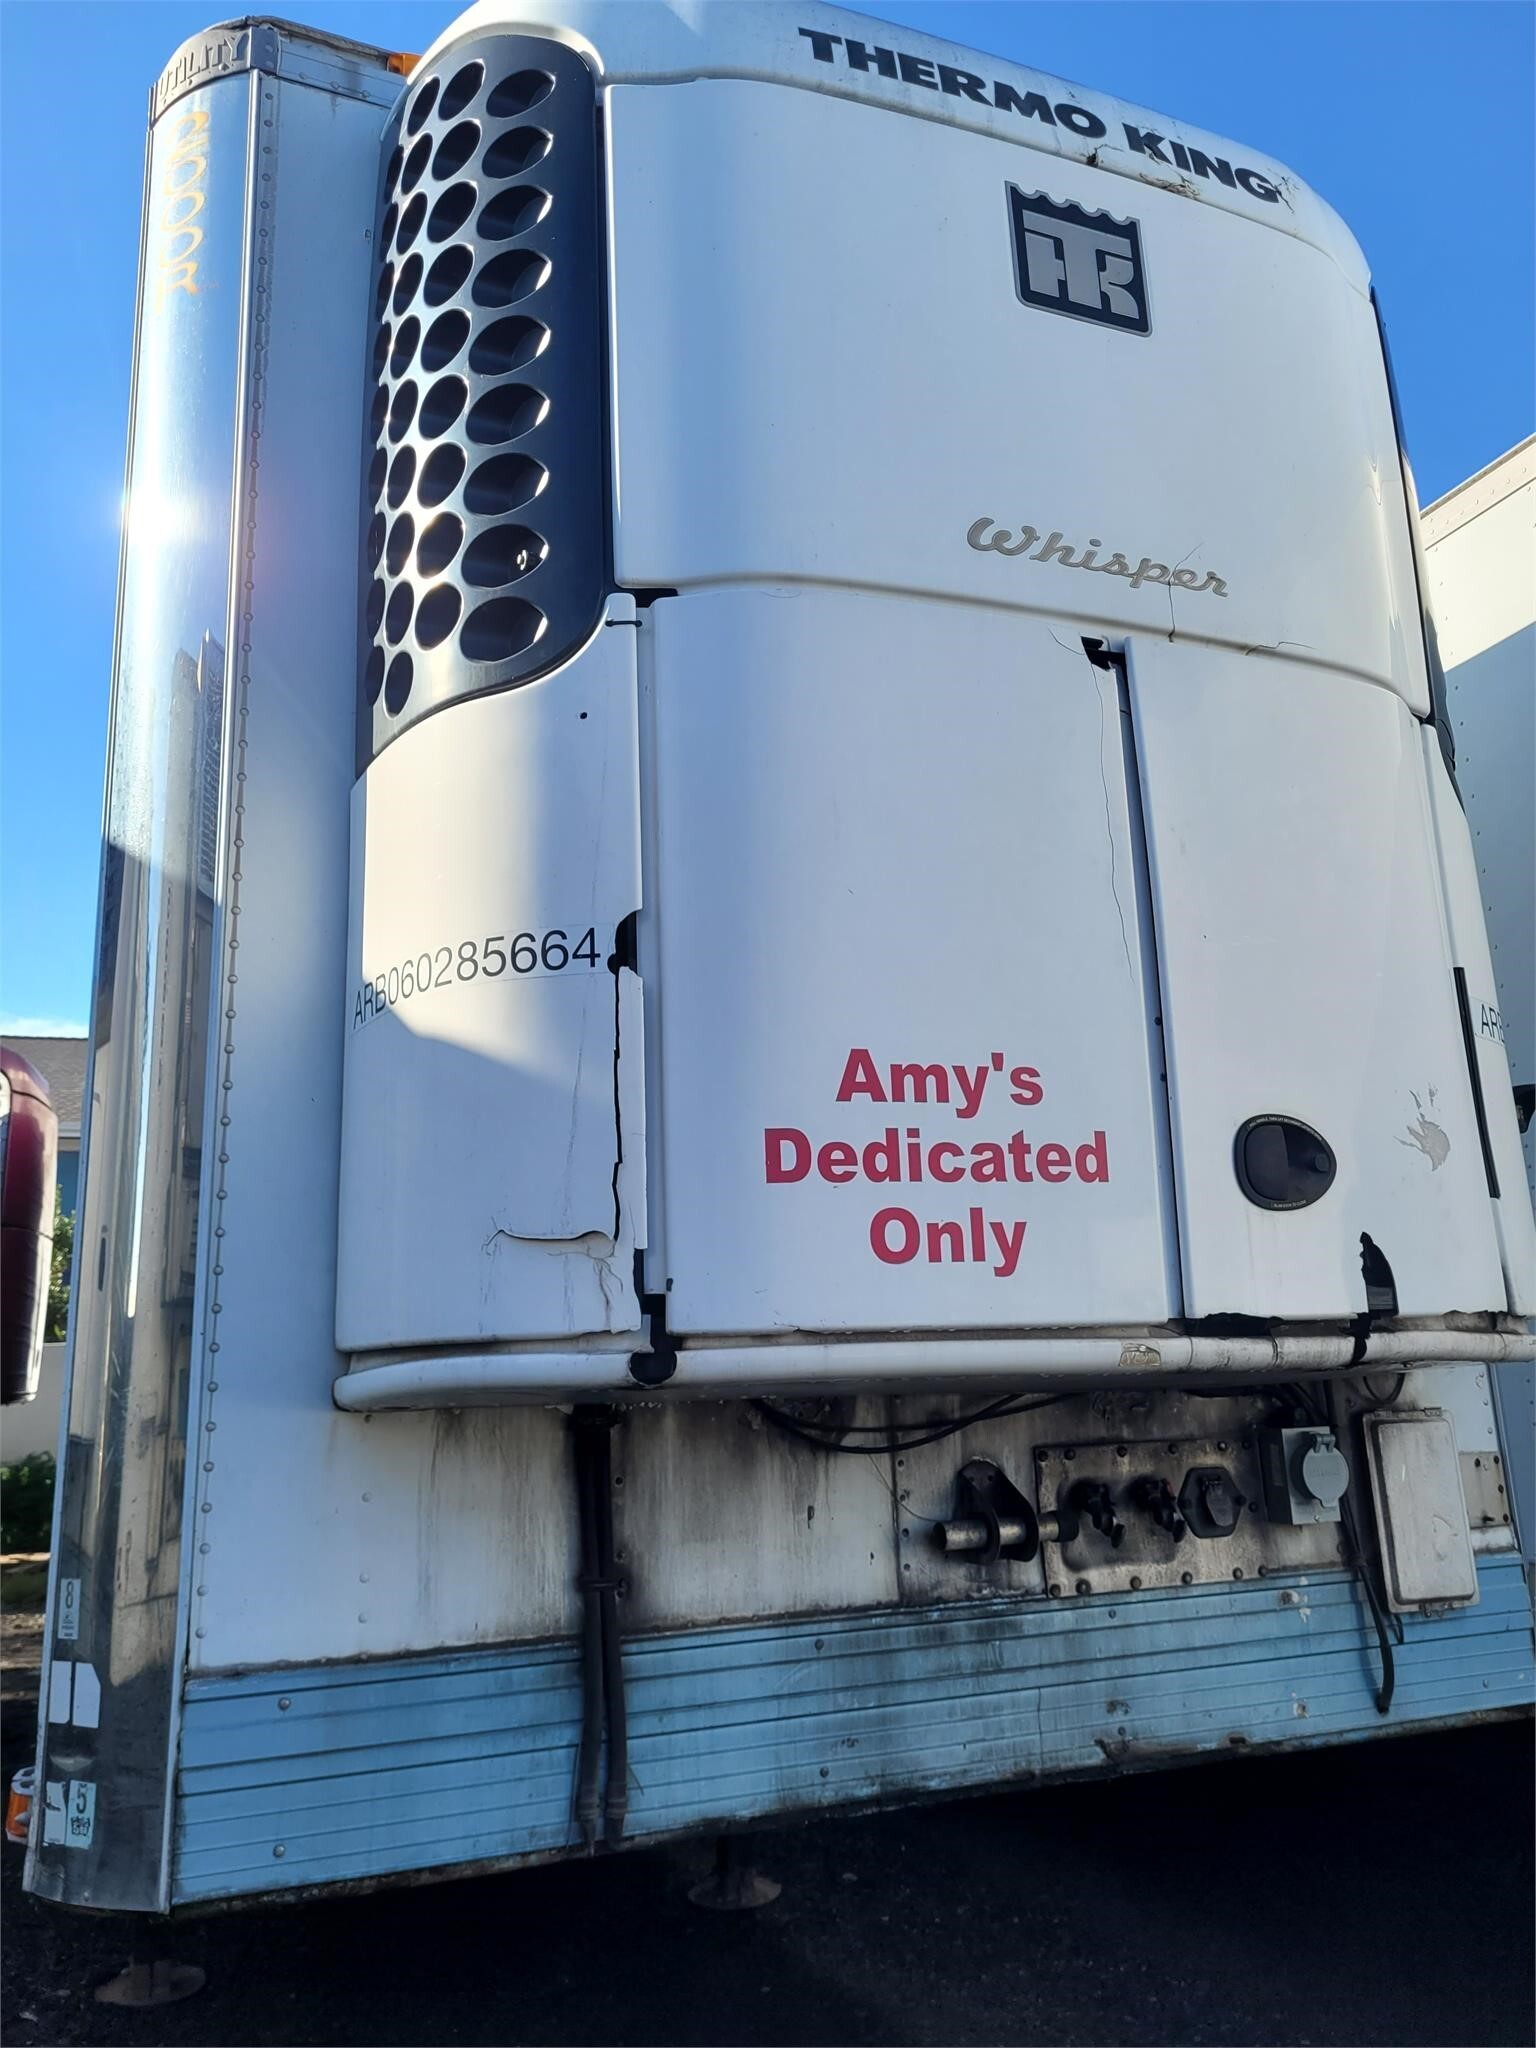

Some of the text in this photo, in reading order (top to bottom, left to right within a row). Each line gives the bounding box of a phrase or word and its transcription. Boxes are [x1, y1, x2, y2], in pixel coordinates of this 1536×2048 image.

[158, 31, 249, 99] UTILITY
[798, 27, 1280, 203] THERMO KING
[966, 517, 1229, 597] Whisper
[353, 927, 601, 1030] ARB060285664
[835, 1048, 1044, 1119] Amy's
[764, 1128, 1110, 1184] Dedicated
[869, 1207, 1028, 1277] Only
